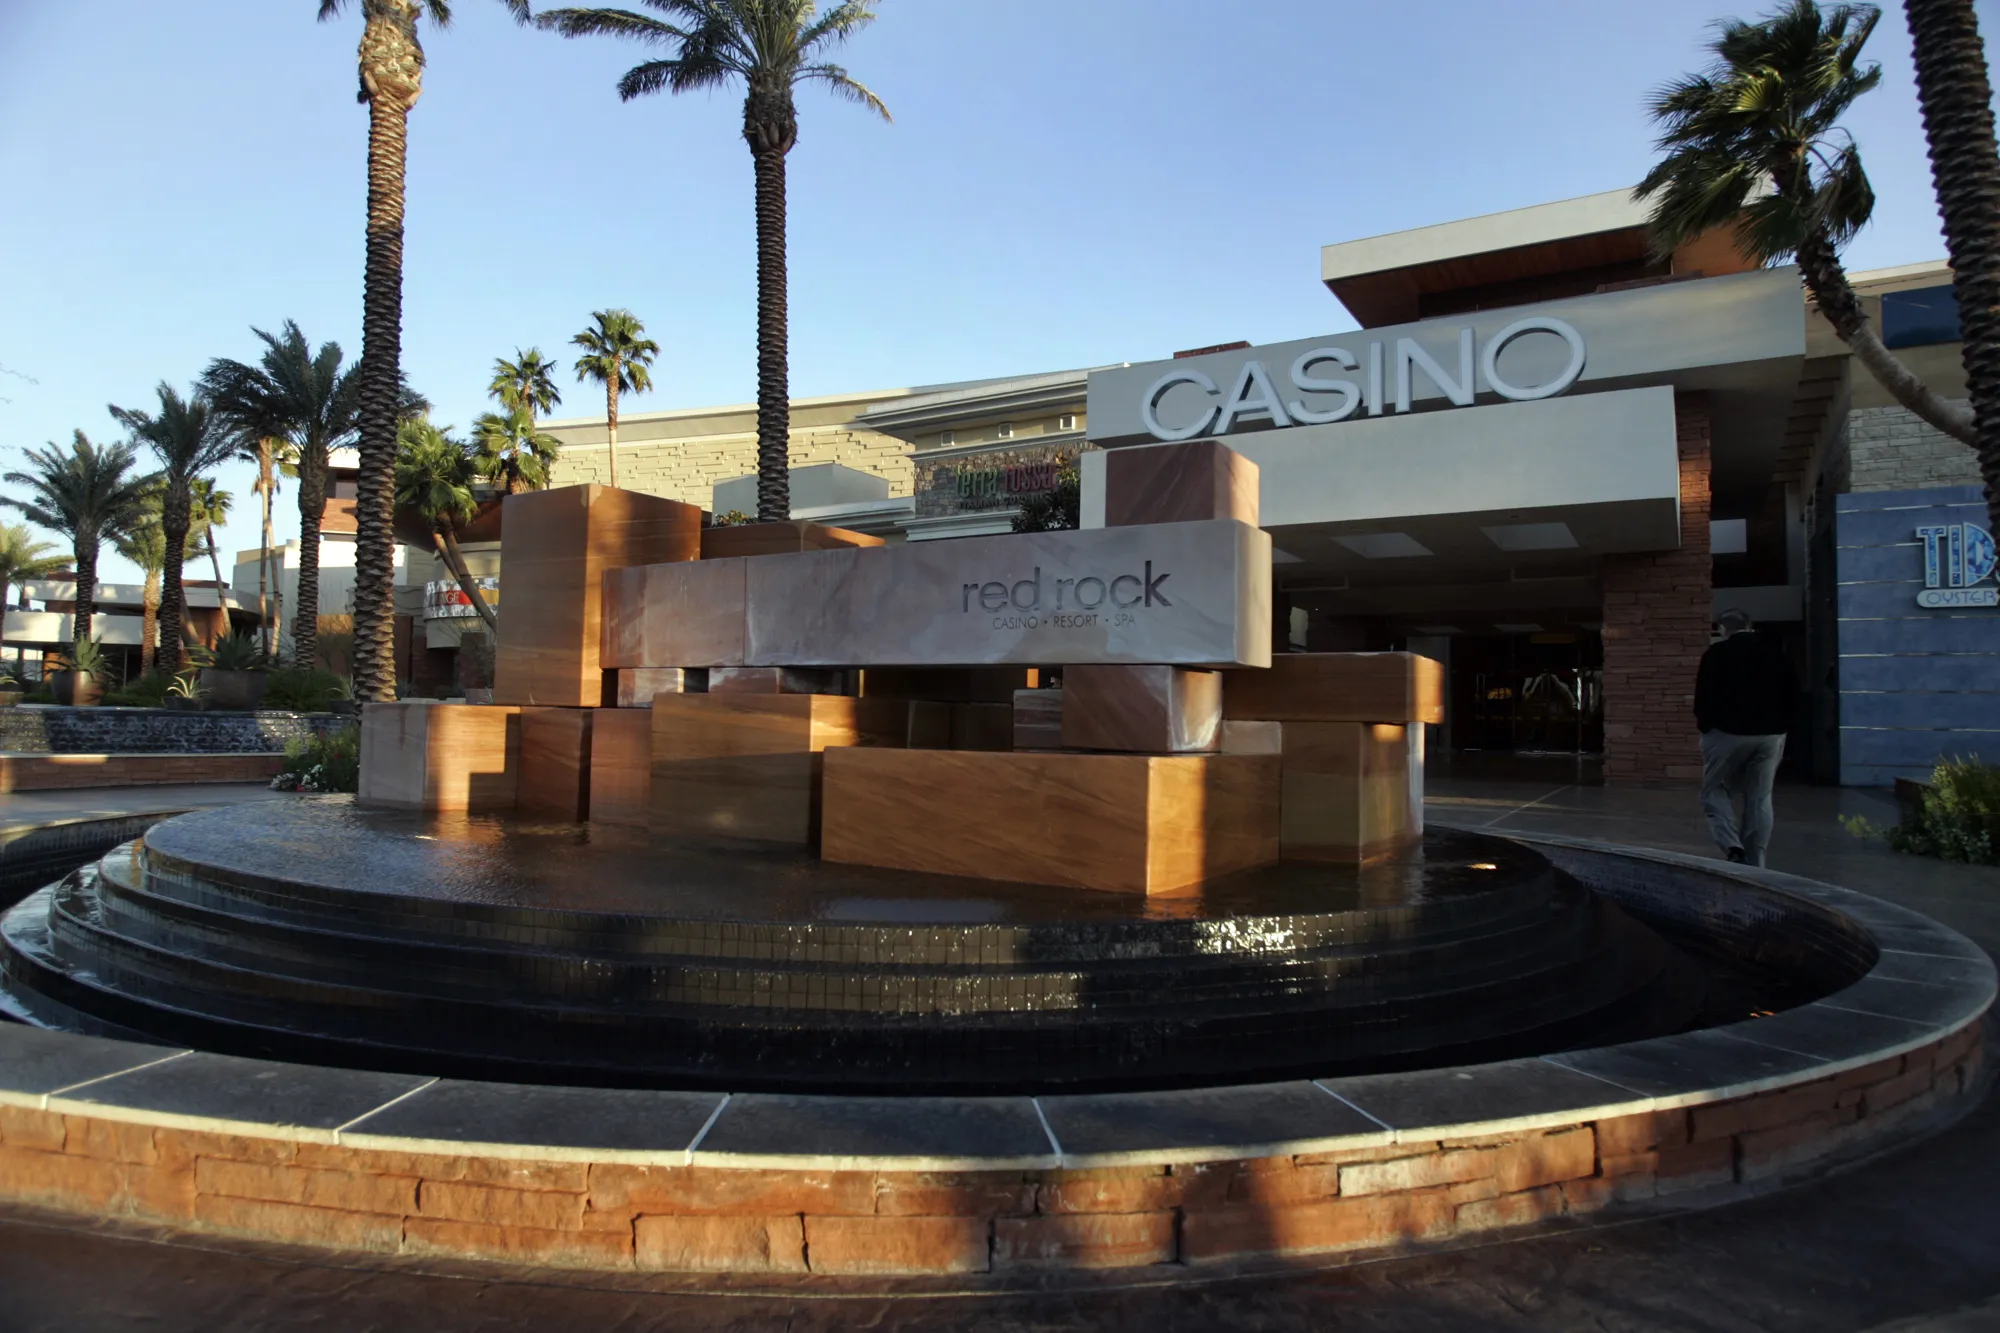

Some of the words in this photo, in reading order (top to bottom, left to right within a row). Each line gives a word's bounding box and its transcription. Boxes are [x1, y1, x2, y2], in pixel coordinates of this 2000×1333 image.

[1141, 316, 1588, 441] CASINO
[955, 465, 998, 498] terra
[1004, 463, 1055, 494] rossa
[1916, 522, 2000, 588] TID
[963, 566, 1041, 613] red
[1056, 560, 1173, 610] rock
[1926, 590, 1996, 605] OYSTER
[992, 616, 1039, 630] CASINO
[1053, 614, 1099, 629] RESORT
[1114, 613, 1136, 627] SPA
